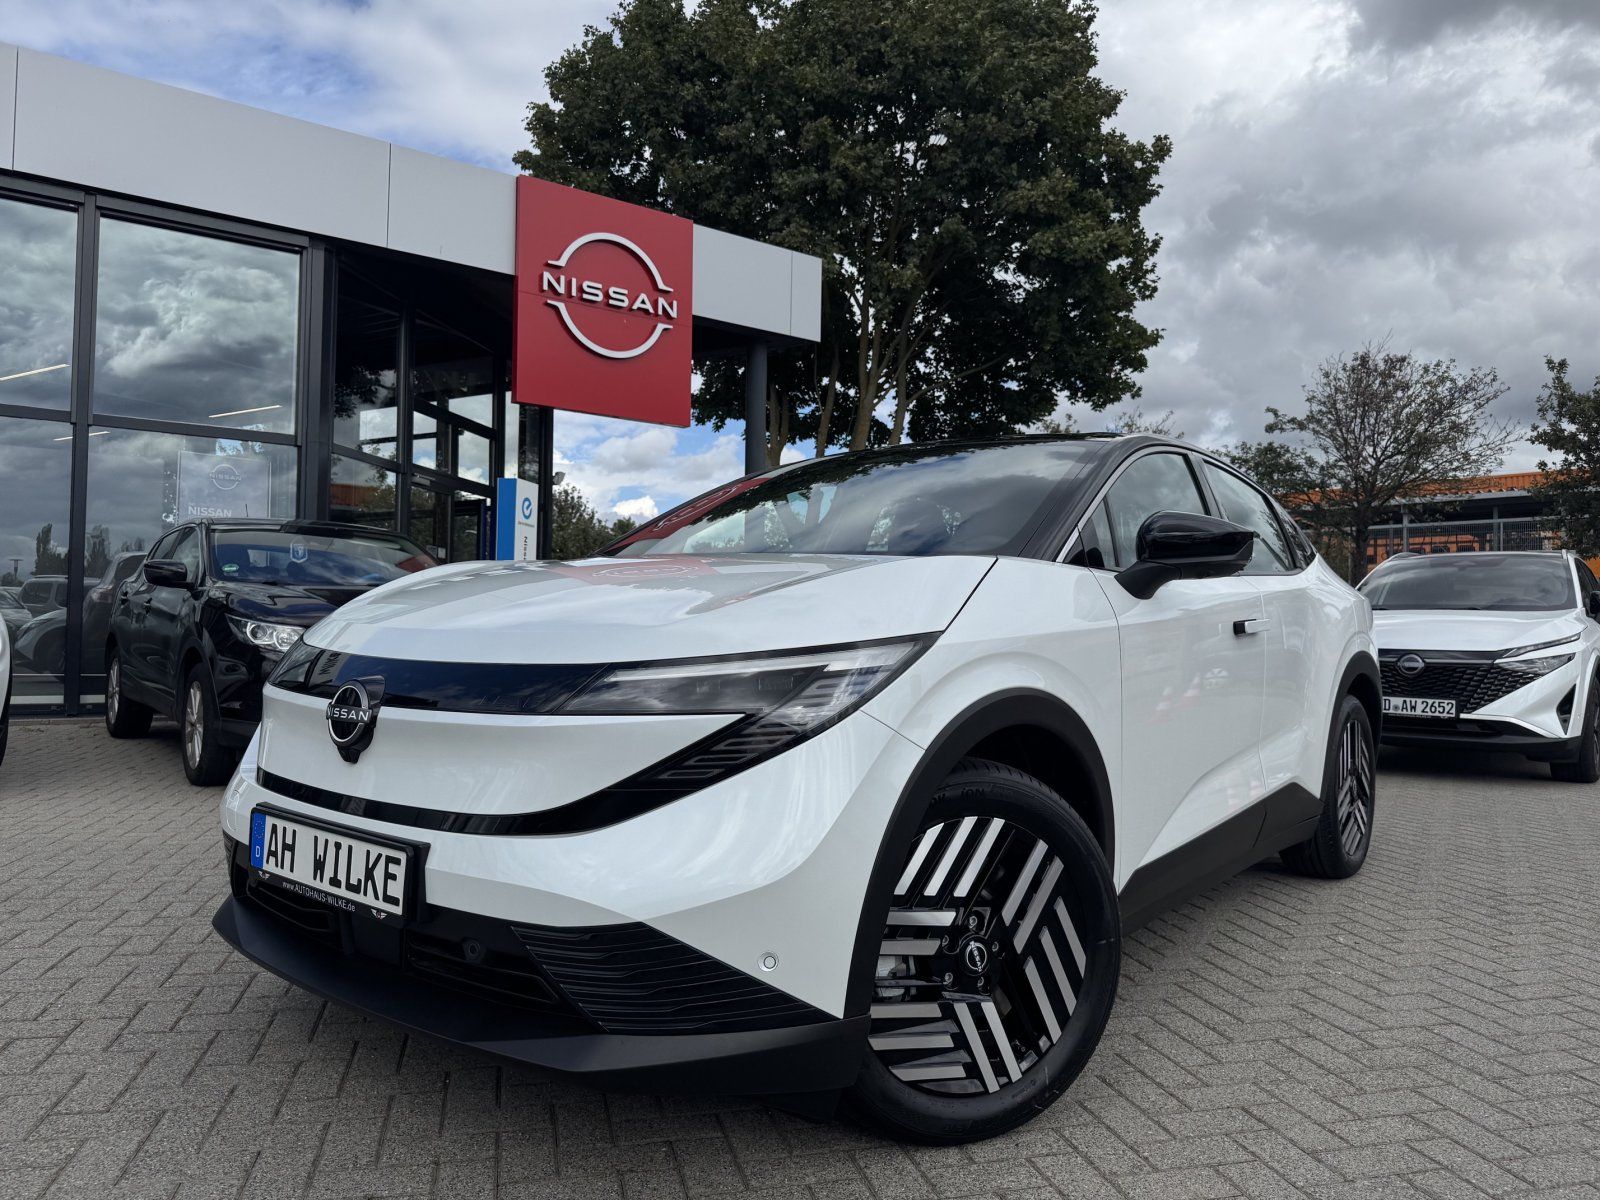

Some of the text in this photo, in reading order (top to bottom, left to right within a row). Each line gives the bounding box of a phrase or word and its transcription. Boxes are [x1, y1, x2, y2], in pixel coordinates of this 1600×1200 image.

[542, 271, 677, 318] NISSAN
[188, 506, 232, 517] NISSAN
[327, 706, 369, 721] NISSAN
[1401, 700, 1417, 713] AW
[1421, 701, 1454, 715] 2652
[255, 823, 402, 907] D AH WILKE
[282, 881, 356, 912] www.AUTOHAUS-WILKE.de
